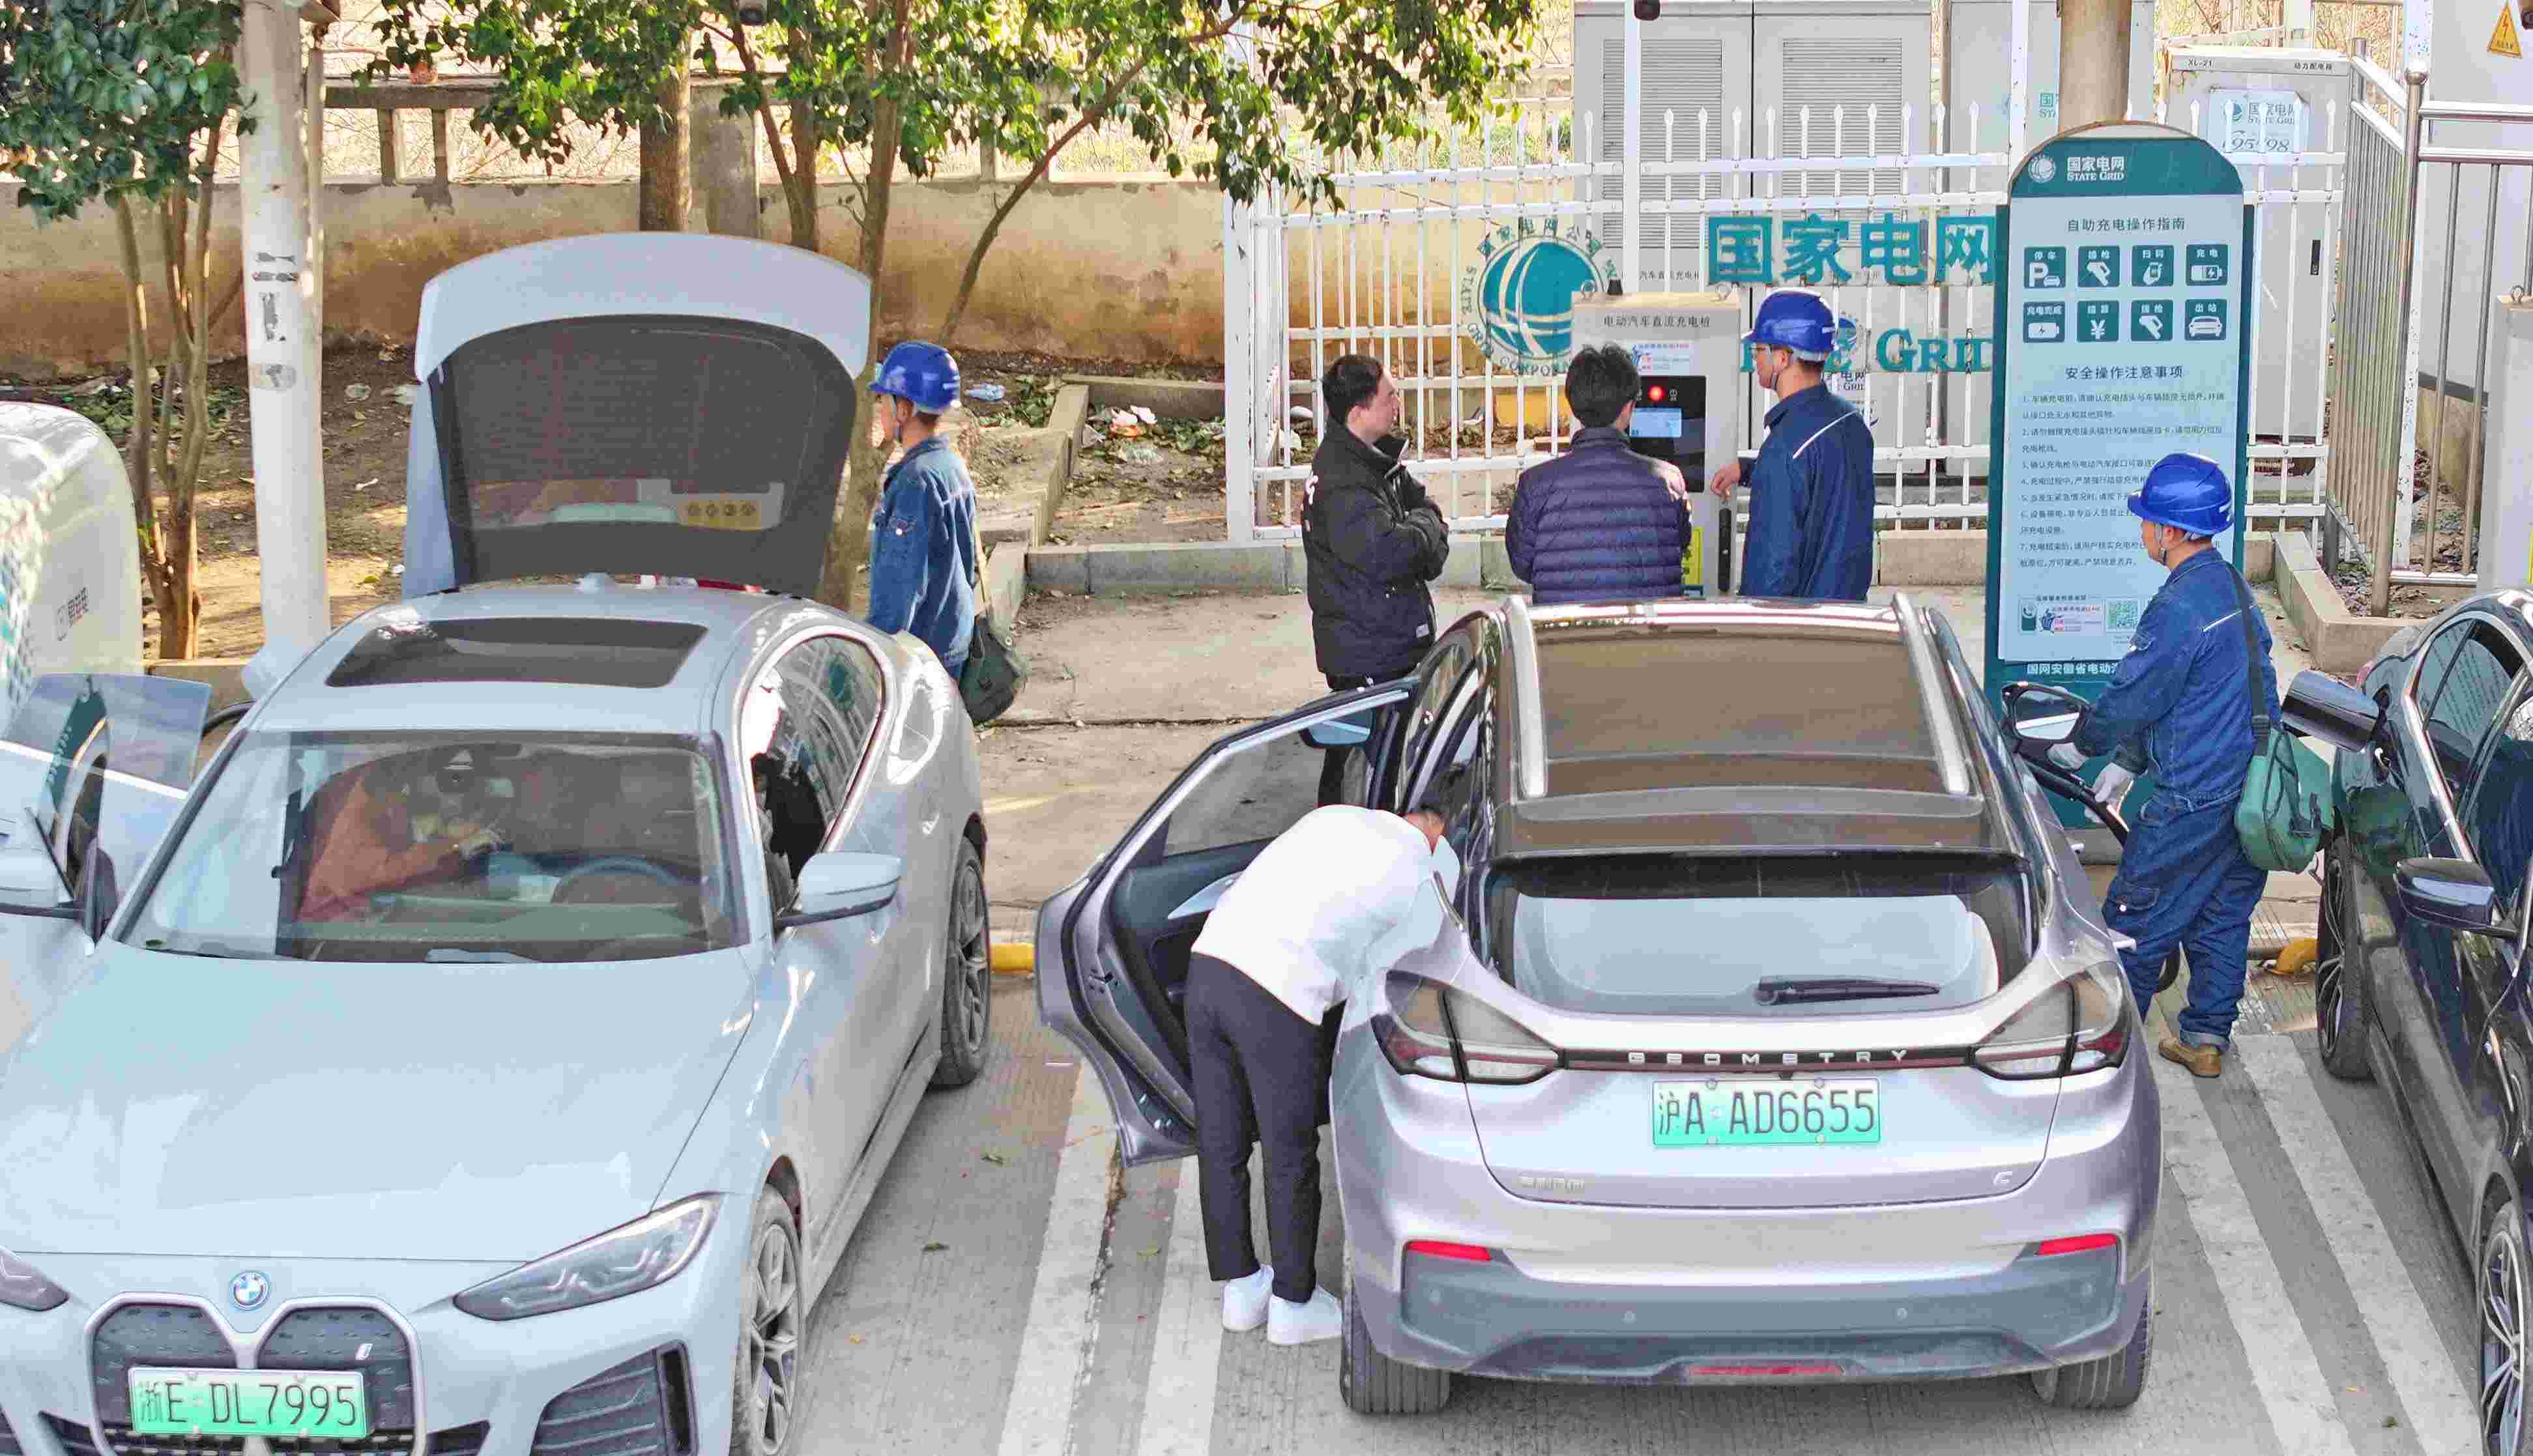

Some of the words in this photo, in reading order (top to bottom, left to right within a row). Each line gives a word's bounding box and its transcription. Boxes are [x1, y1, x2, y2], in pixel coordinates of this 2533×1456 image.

[2067, 156, 2124, 171] 国家电网
[2066, 171, 2096, 181] STATE
[2100, 171, 2124, 180] GRID
[2068, 218, 2185, 231] 自助充电操作指南
[1709, 213, 1995, 283] 国家电网
[1604, 315, 1710, 328] 电动汽车直流充电桩
[2066, 365, 2184, 380] 安全操作注意事项
[1730, 1090, 1875, 1134] AD6655
[209, 1382, 356, 1427] DL7995
